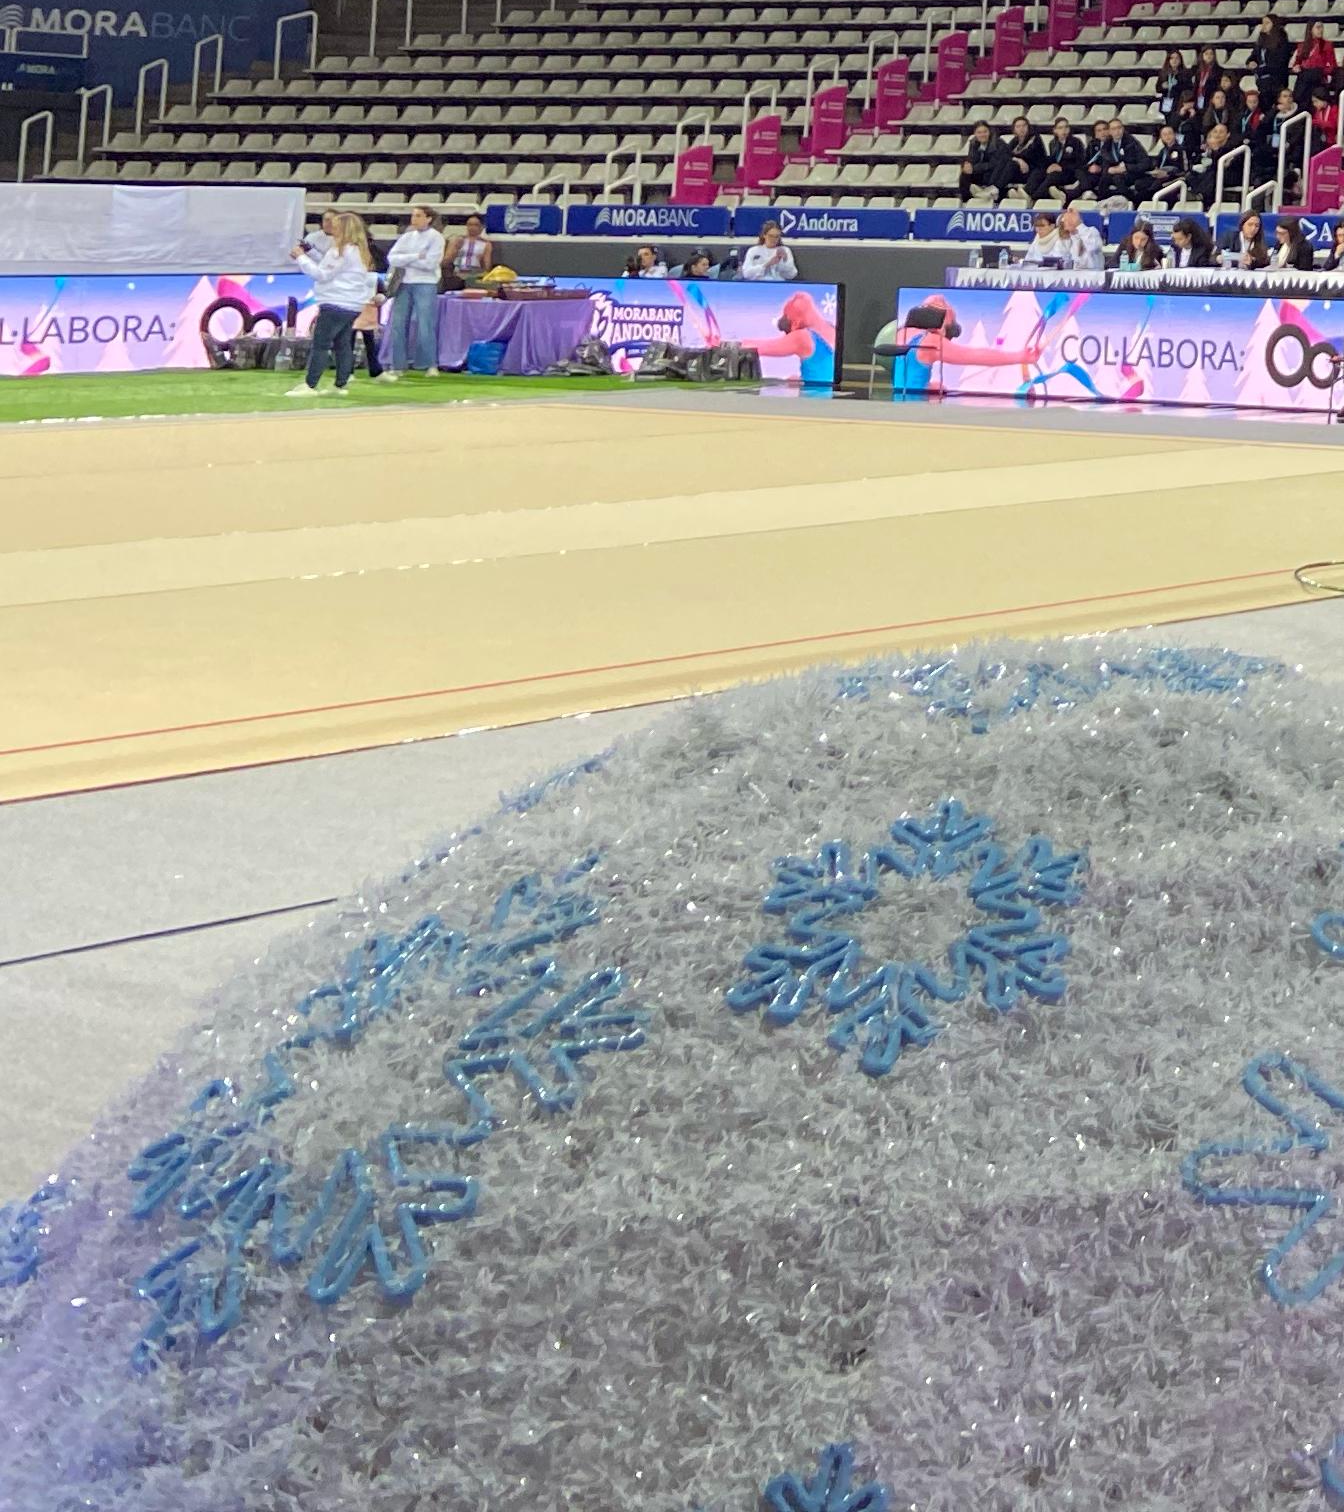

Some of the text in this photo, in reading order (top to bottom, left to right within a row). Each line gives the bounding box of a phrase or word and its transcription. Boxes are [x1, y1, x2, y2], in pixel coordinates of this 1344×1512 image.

[30, 6, 252, 44] MORABANC
[610, 207, 699, 229] MORABANC
[797, 211, 858, 233] Andorra
[613, 306, 682, 322] MORABANC
[612, 323, 680, 344] ANDORRA
